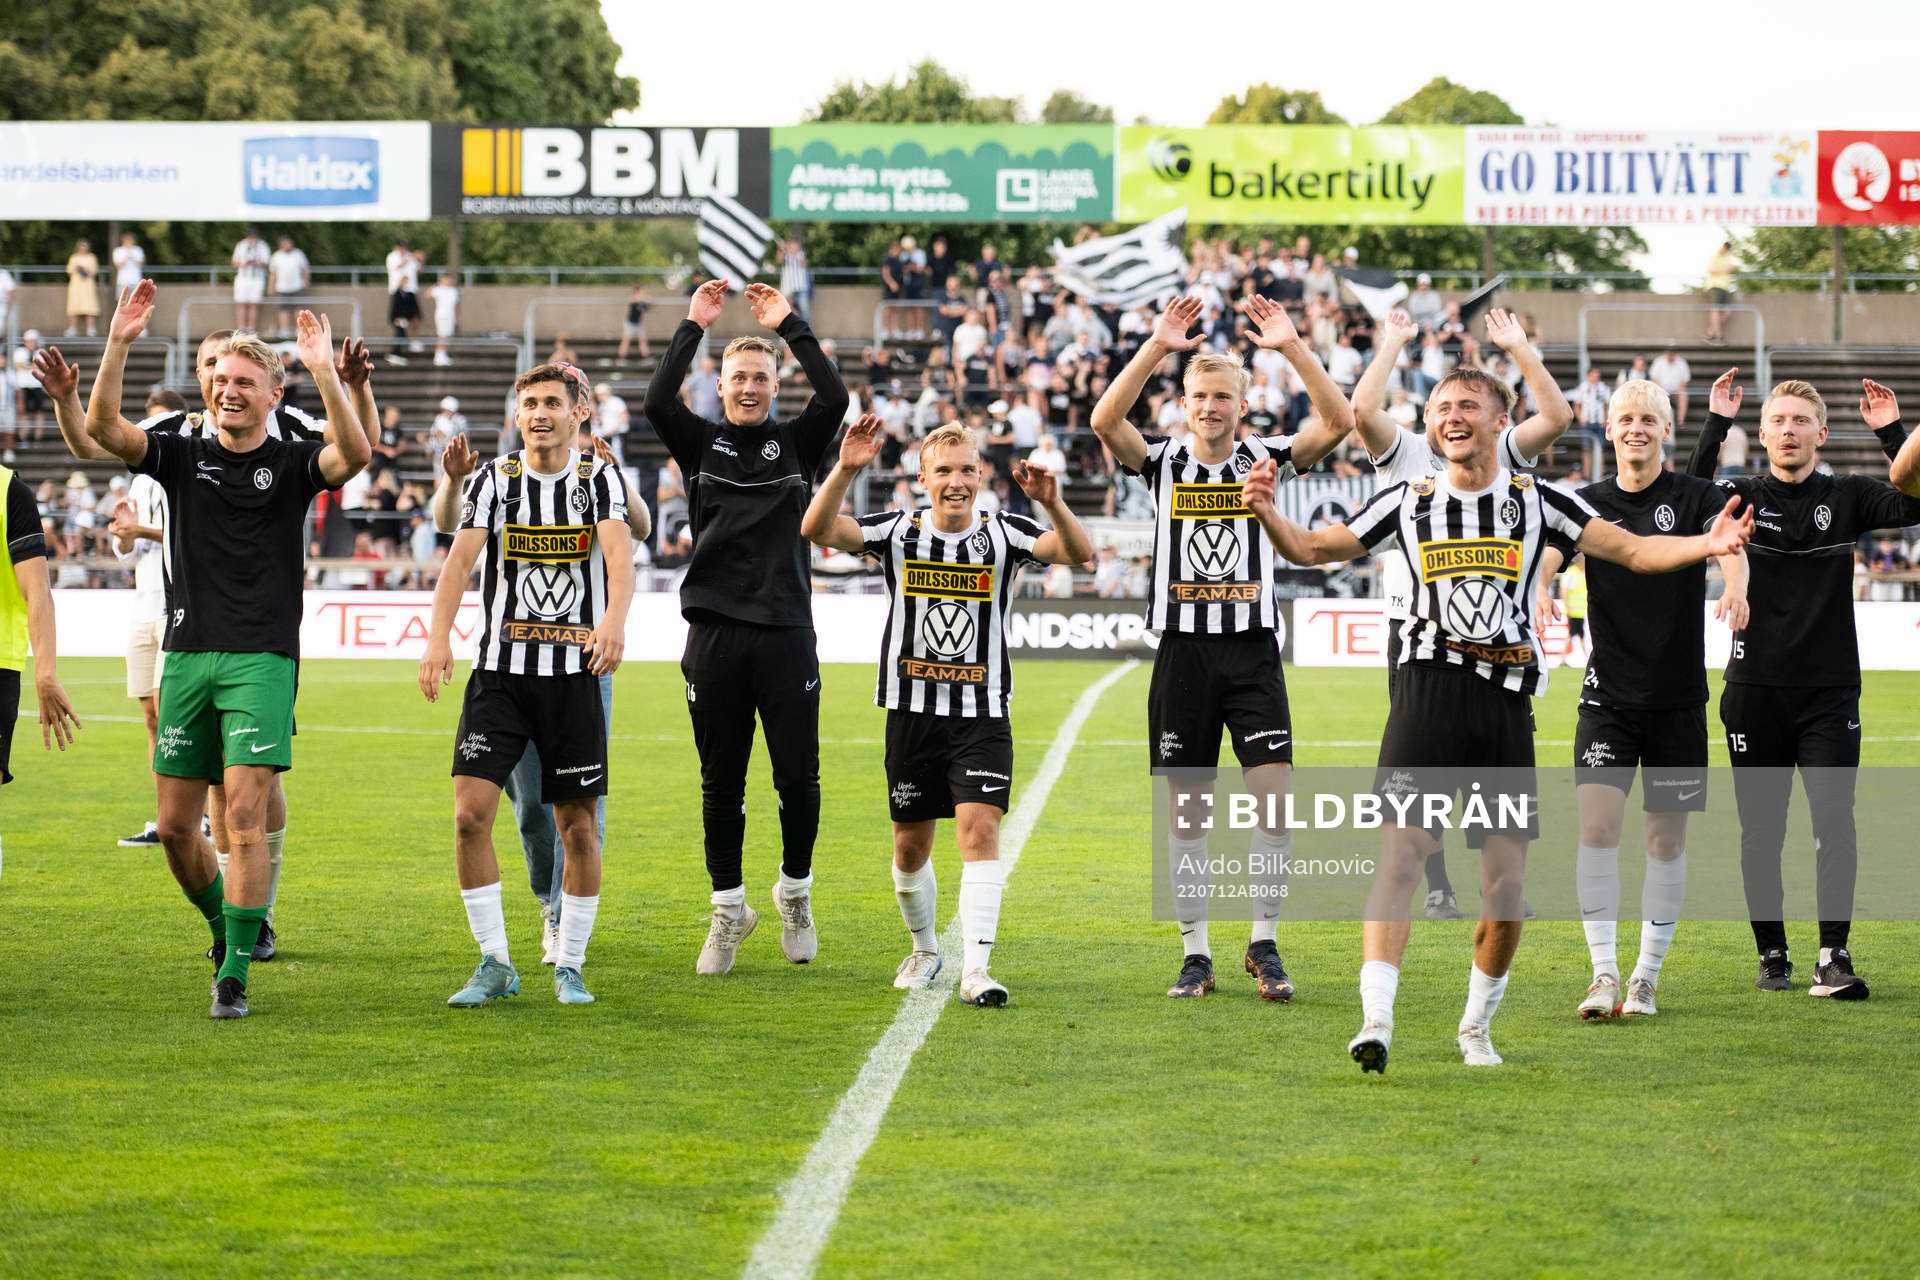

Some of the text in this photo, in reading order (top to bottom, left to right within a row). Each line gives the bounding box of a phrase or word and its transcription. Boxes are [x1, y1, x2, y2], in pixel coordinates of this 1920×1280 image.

[250, 154, 374, 190] Haldex
[521, 127, 739, 197] BBM
[1480, 142, 1751, 194] GO BILTVÄTT
[788, 163, 952, 192] Allmän nytta.
[1209, 161, 1436, 211] bakertilly
[789, 187, 831, 211] För
[833, 188, 892, 212] allas
[1177, 494, 1242, 509] OHLSSONS
[508, 536, 578, 552] OHLSSONS
[1426, 549, 1505, 570] OHLSSONS
[907, 570, 978, 590] OHLSSONS
[1170, 584, 1260, 600] TEAMAB
[1391, 596, 1404, 607] TK
[503, 623, 591, 643] TEAMAB
[1733, 640, 1745, 659] 15
[900, 659, 986, 682] TEAMAB
[1584, 667, 1599, 689] 24
[1730, 733, 1747, 753] 15
